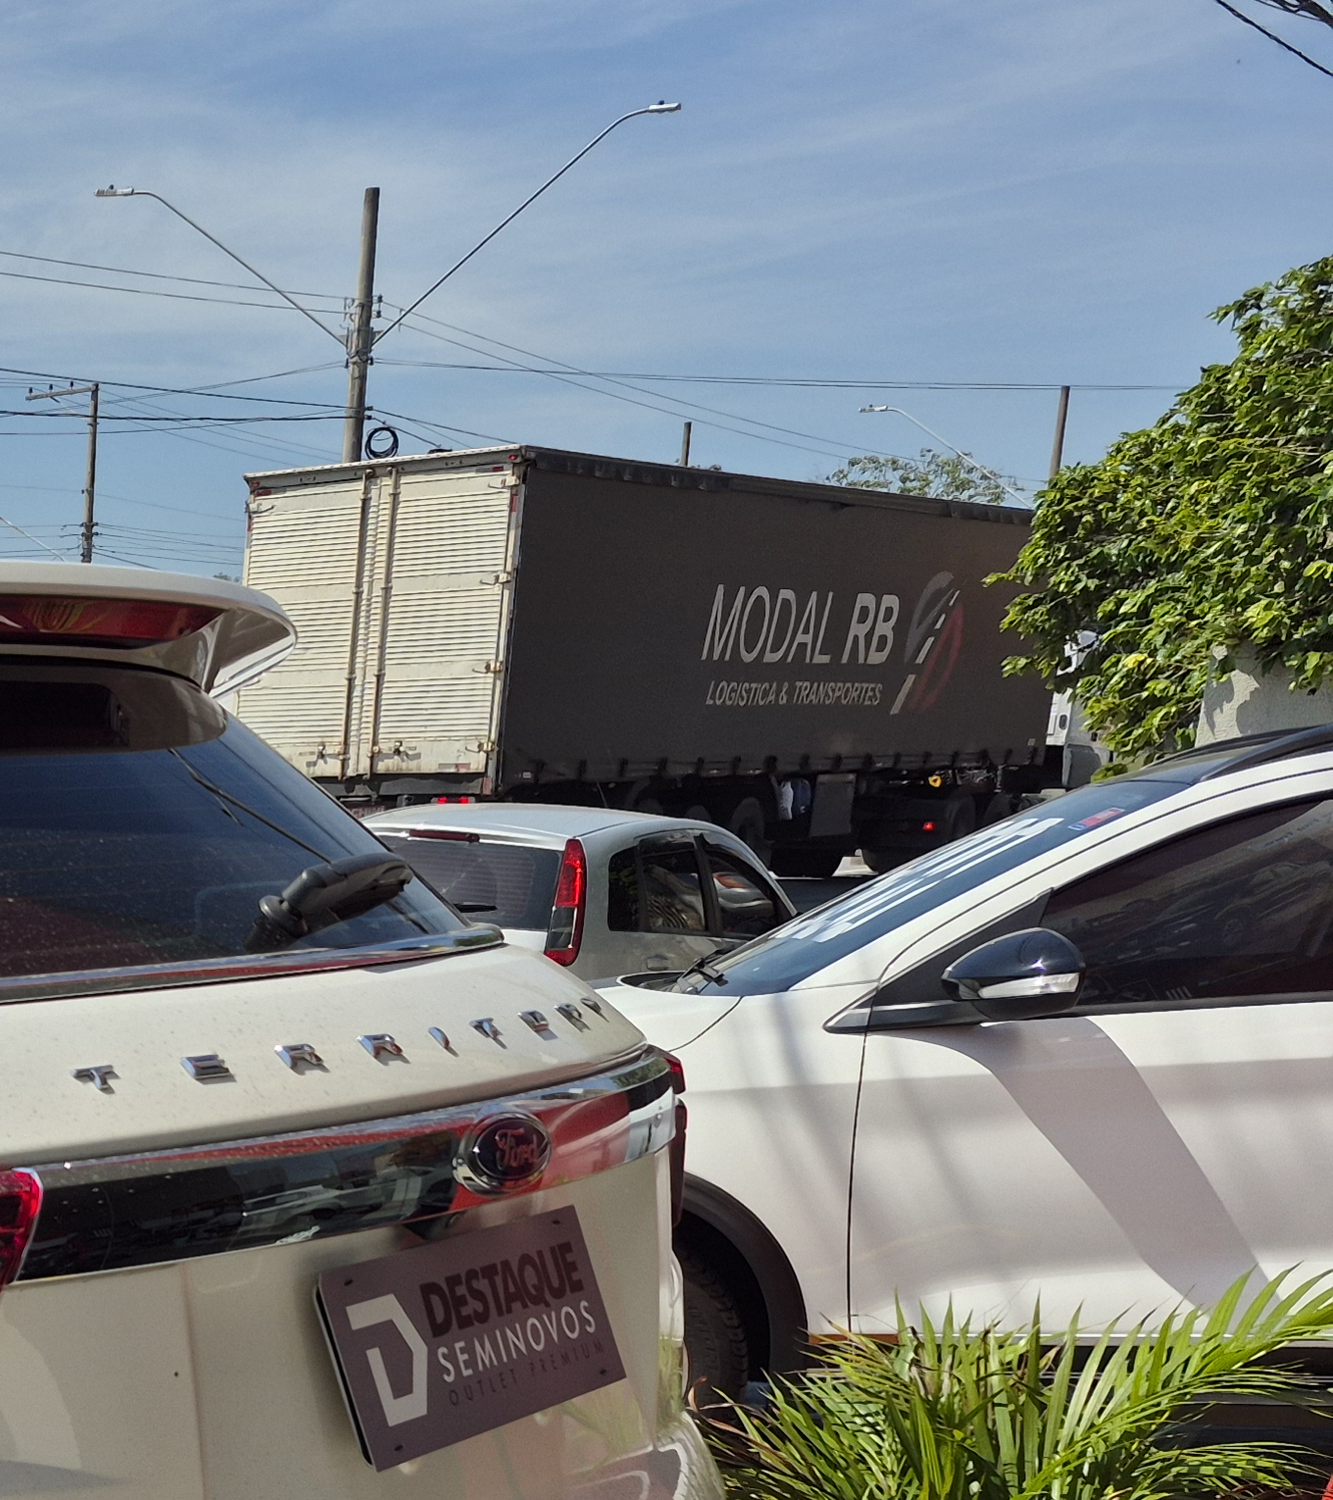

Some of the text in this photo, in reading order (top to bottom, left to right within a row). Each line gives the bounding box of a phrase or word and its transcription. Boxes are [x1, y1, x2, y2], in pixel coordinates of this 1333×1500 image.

[701, 584, 900, 664] MODAL RB
[778, 681, 789, 705] &
[793, 681, 883, 705] TRANSPORTES
[419, 1241, 585, 1338] DESTAQUE
[437, 1300, 596, 1382] SEMINOVOS
[448, 1341, 606, 1406] OUTLET PREMIUM
